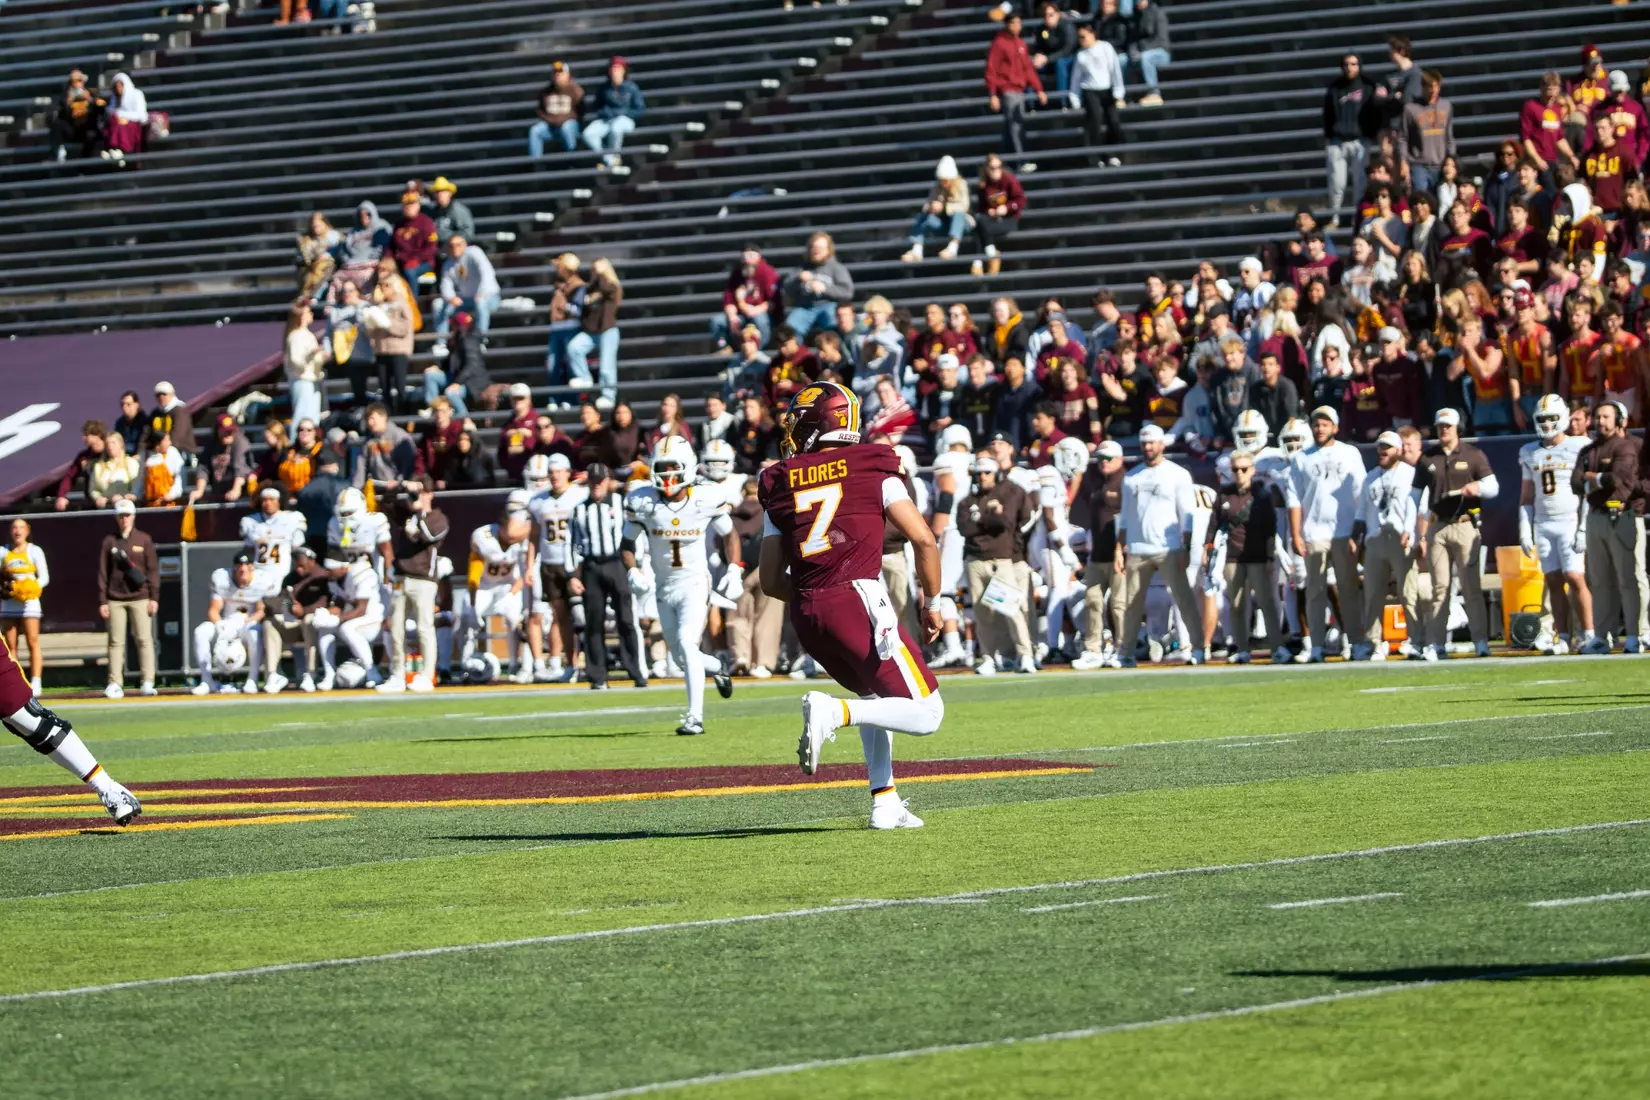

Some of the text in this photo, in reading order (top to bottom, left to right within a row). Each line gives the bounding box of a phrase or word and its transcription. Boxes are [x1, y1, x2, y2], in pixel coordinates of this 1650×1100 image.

[789, 459, 848, 488] FLORES
[1541, 470, 1556, 496] 0
[651, 528, 701, 537] BRONCOS
[793, 482, 844, 559] 7
[257, 542, 281, 565] 24
[669, 539, 683, 568] 1
